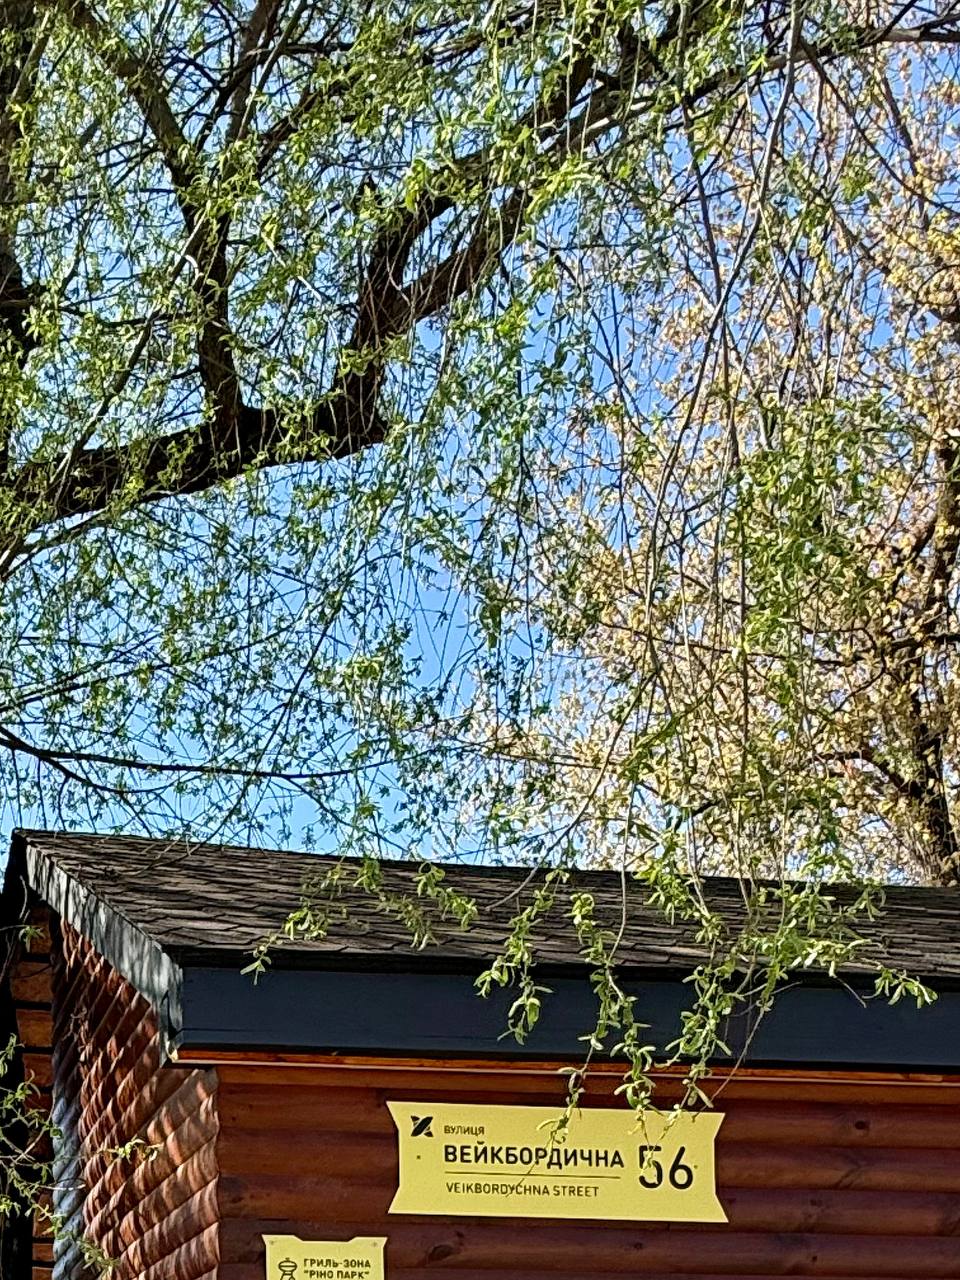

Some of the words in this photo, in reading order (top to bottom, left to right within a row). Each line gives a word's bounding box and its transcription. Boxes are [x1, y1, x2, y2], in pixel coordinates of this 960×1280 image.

[443, 1125, 485, 1137] ВУЛИЦЯ
[443, 1140, 625, 1170] ВЕЙКБОРДИЧНА
[638, 1145, 694, 1190] 56
[446, 1182, 550, 1196] VEIKBORDYCHNA
[553, 1186, 600, 1197] STREET
[303, 1258, 371, 1268] ГРИЛЬ-ЗОНА
